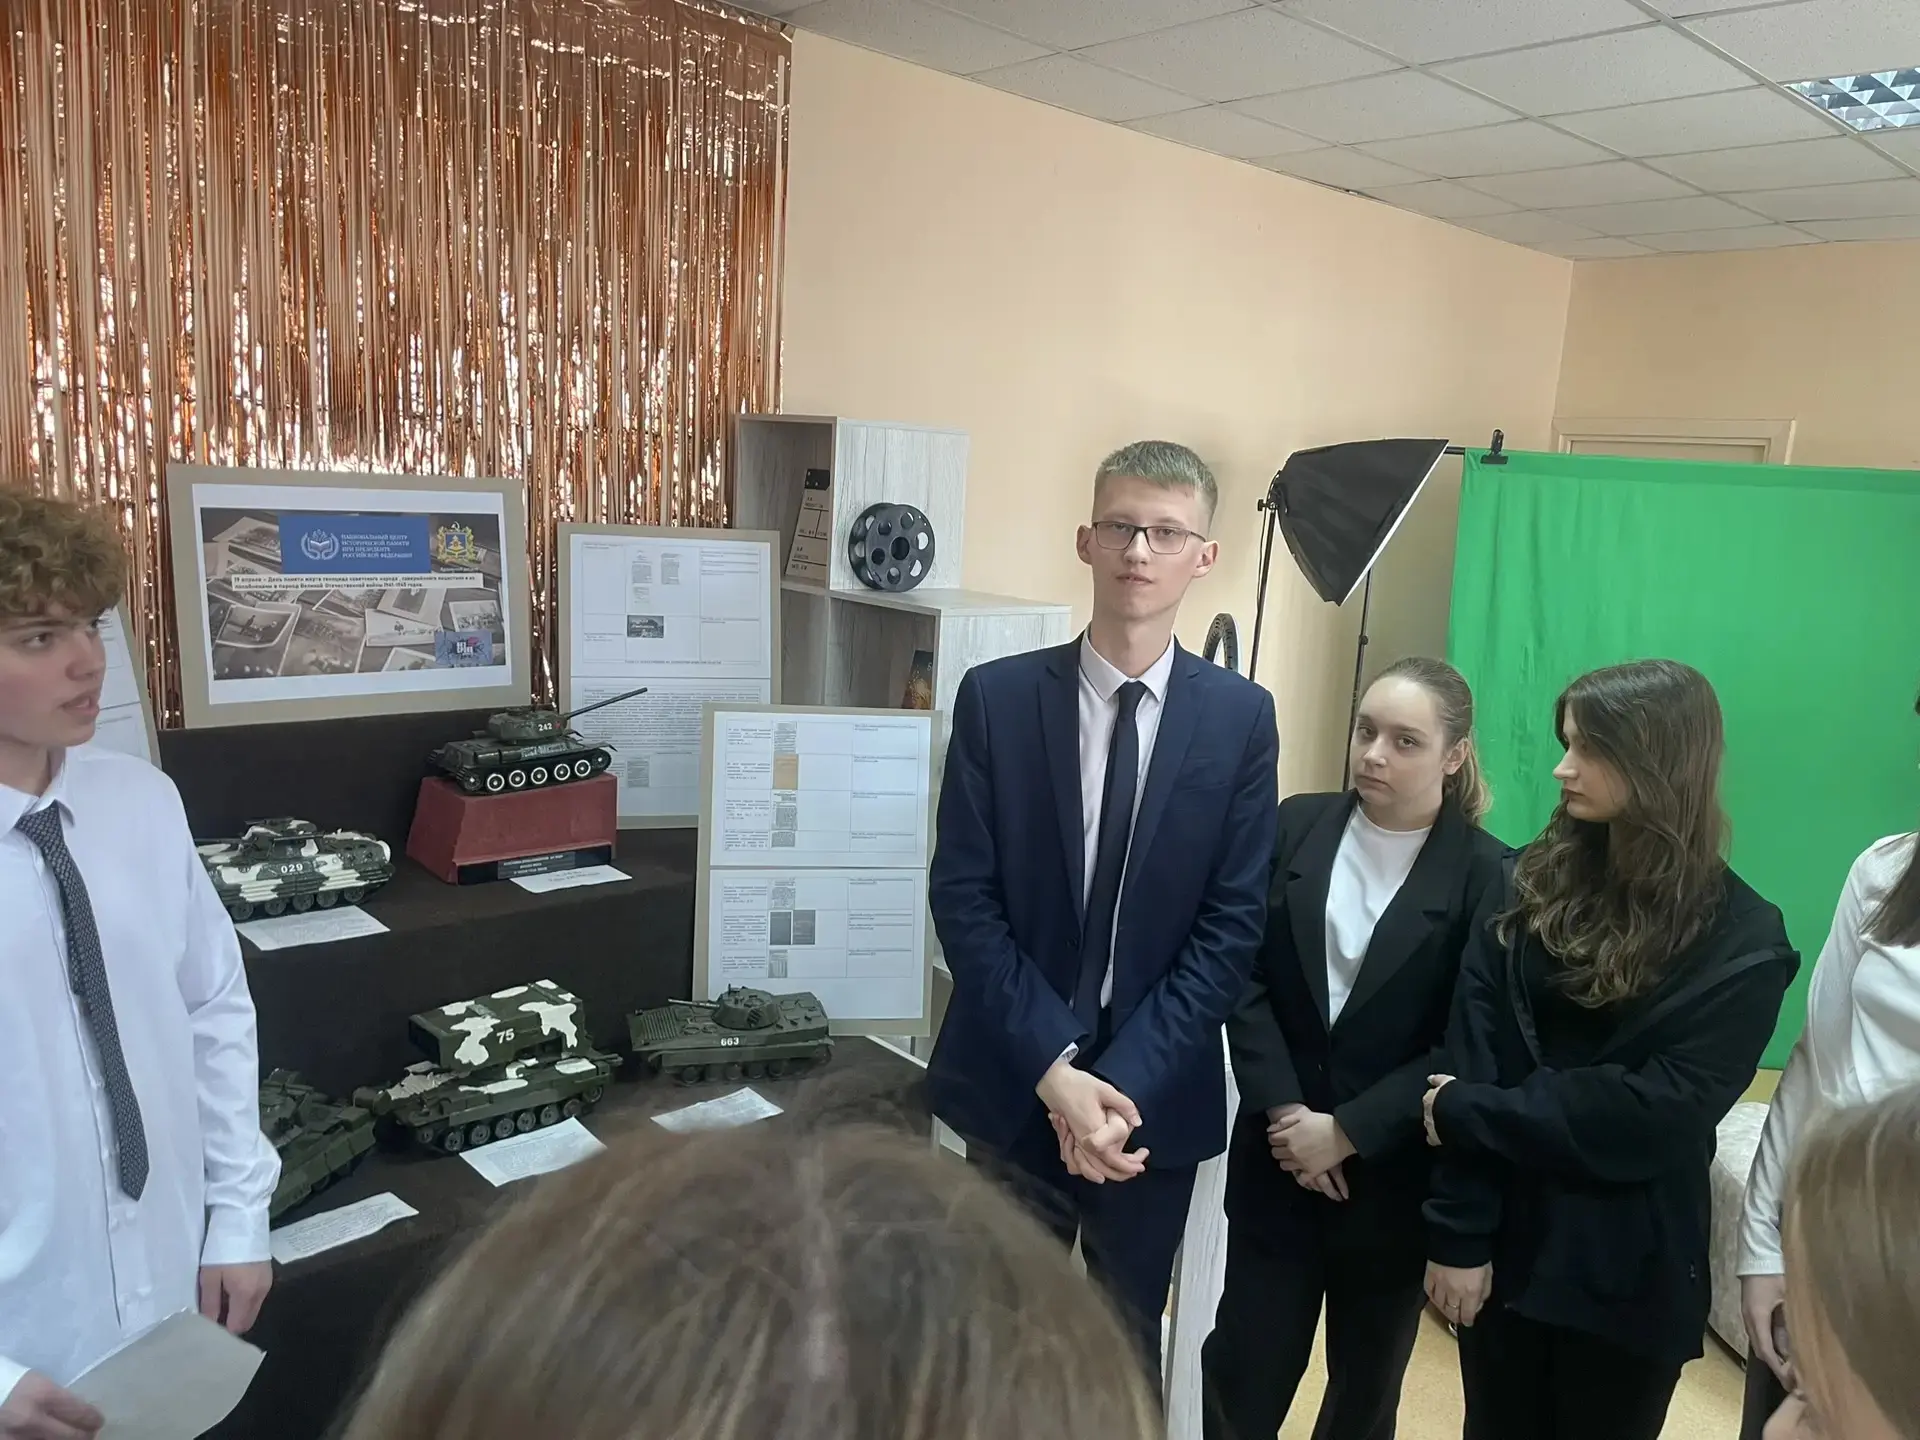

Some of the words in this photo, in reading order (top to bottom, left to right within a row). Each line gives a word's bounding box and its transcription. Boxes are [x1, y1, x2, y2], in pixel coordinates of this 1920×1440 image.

[538, 723, 552, 731] 242
[281, 863, 303, 874] 029
[496, 1028, 515, 1044] 75
[720, 1036, 740, 1046] 663
